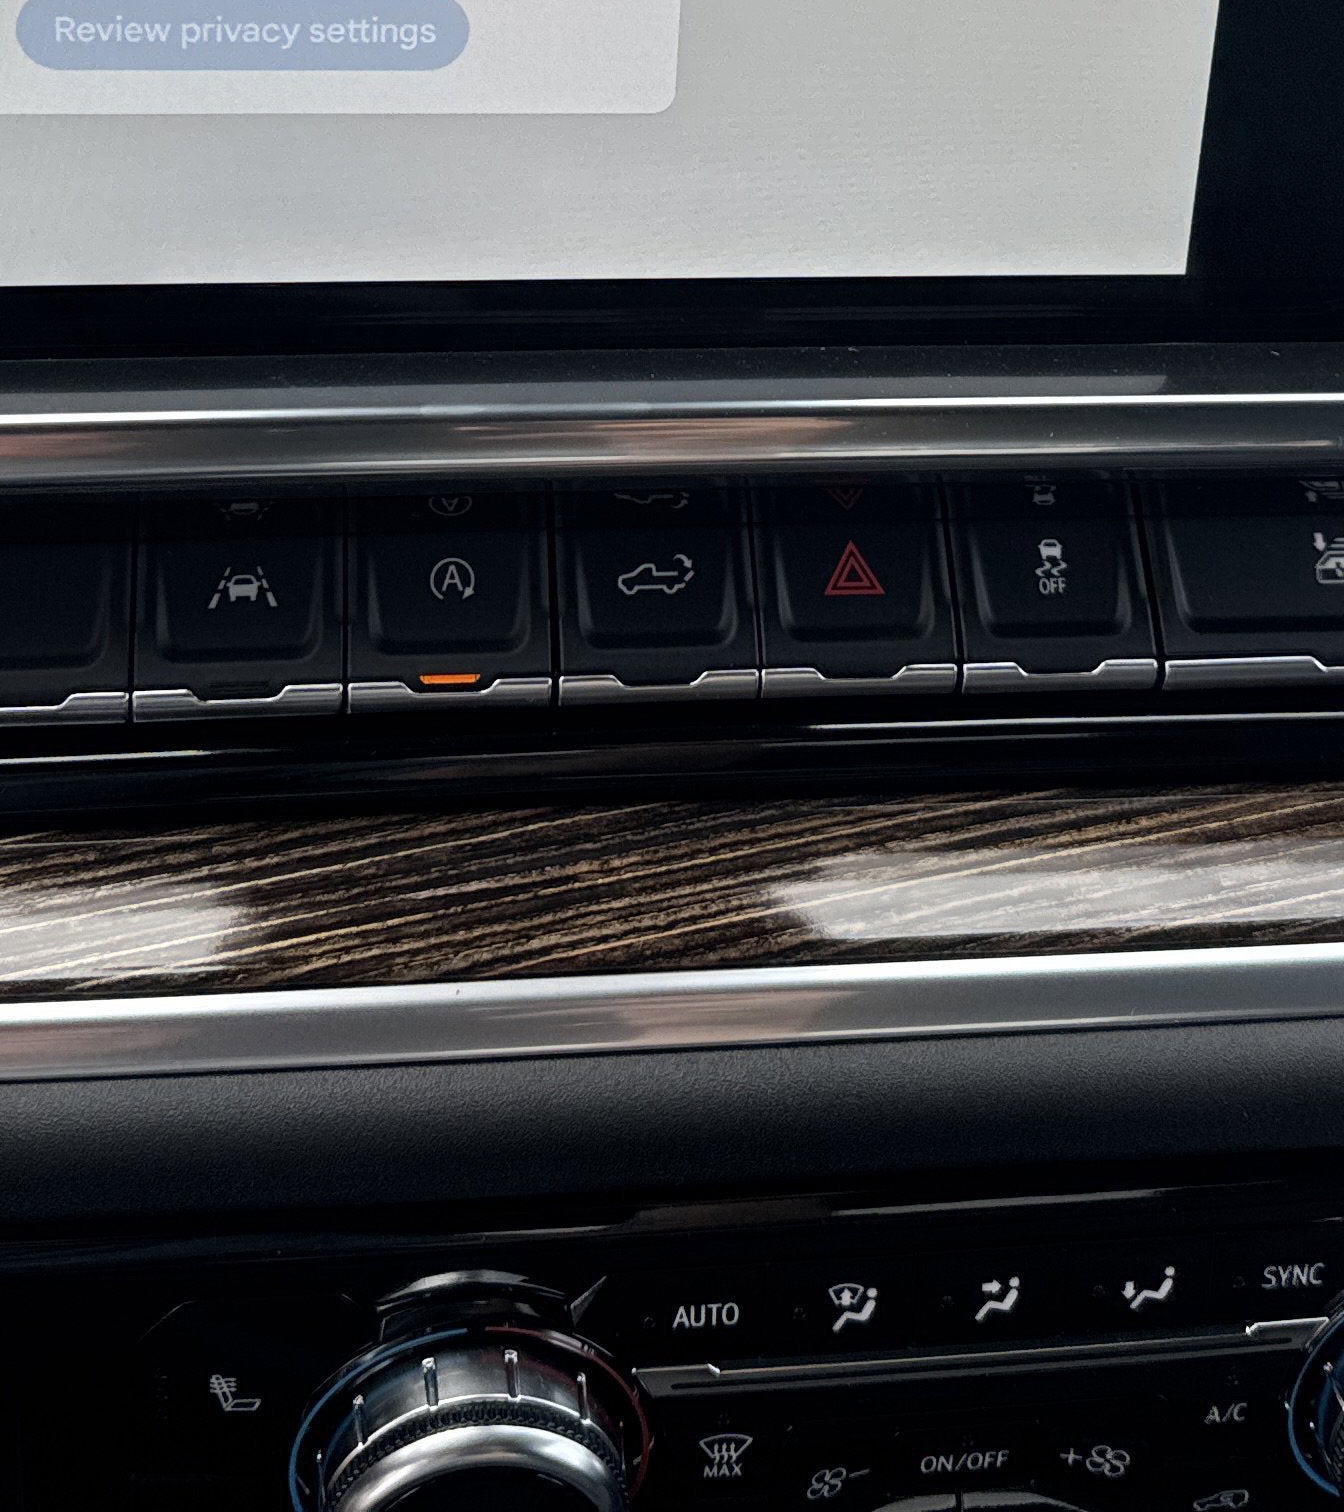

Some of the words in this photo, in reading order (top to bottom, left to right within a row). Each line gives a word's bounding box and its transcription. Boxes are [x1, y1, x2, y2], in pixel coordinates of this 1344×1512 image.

[55, 15, 171, 42] Review
[182, 16, 300, 49] privacy
[310, 16, 436, 50] settings
[1039, 578, 1065, 594] OFF
[1262, 1263, 1324, 1288] SYNC
[673, 1303, 739, 1328] AUTO
[1205, 1403, 1247, 1423] A/C
[703, 1461, 743, 1478] MAX
[920, 1451, 1008, 1473] ON/OFF
